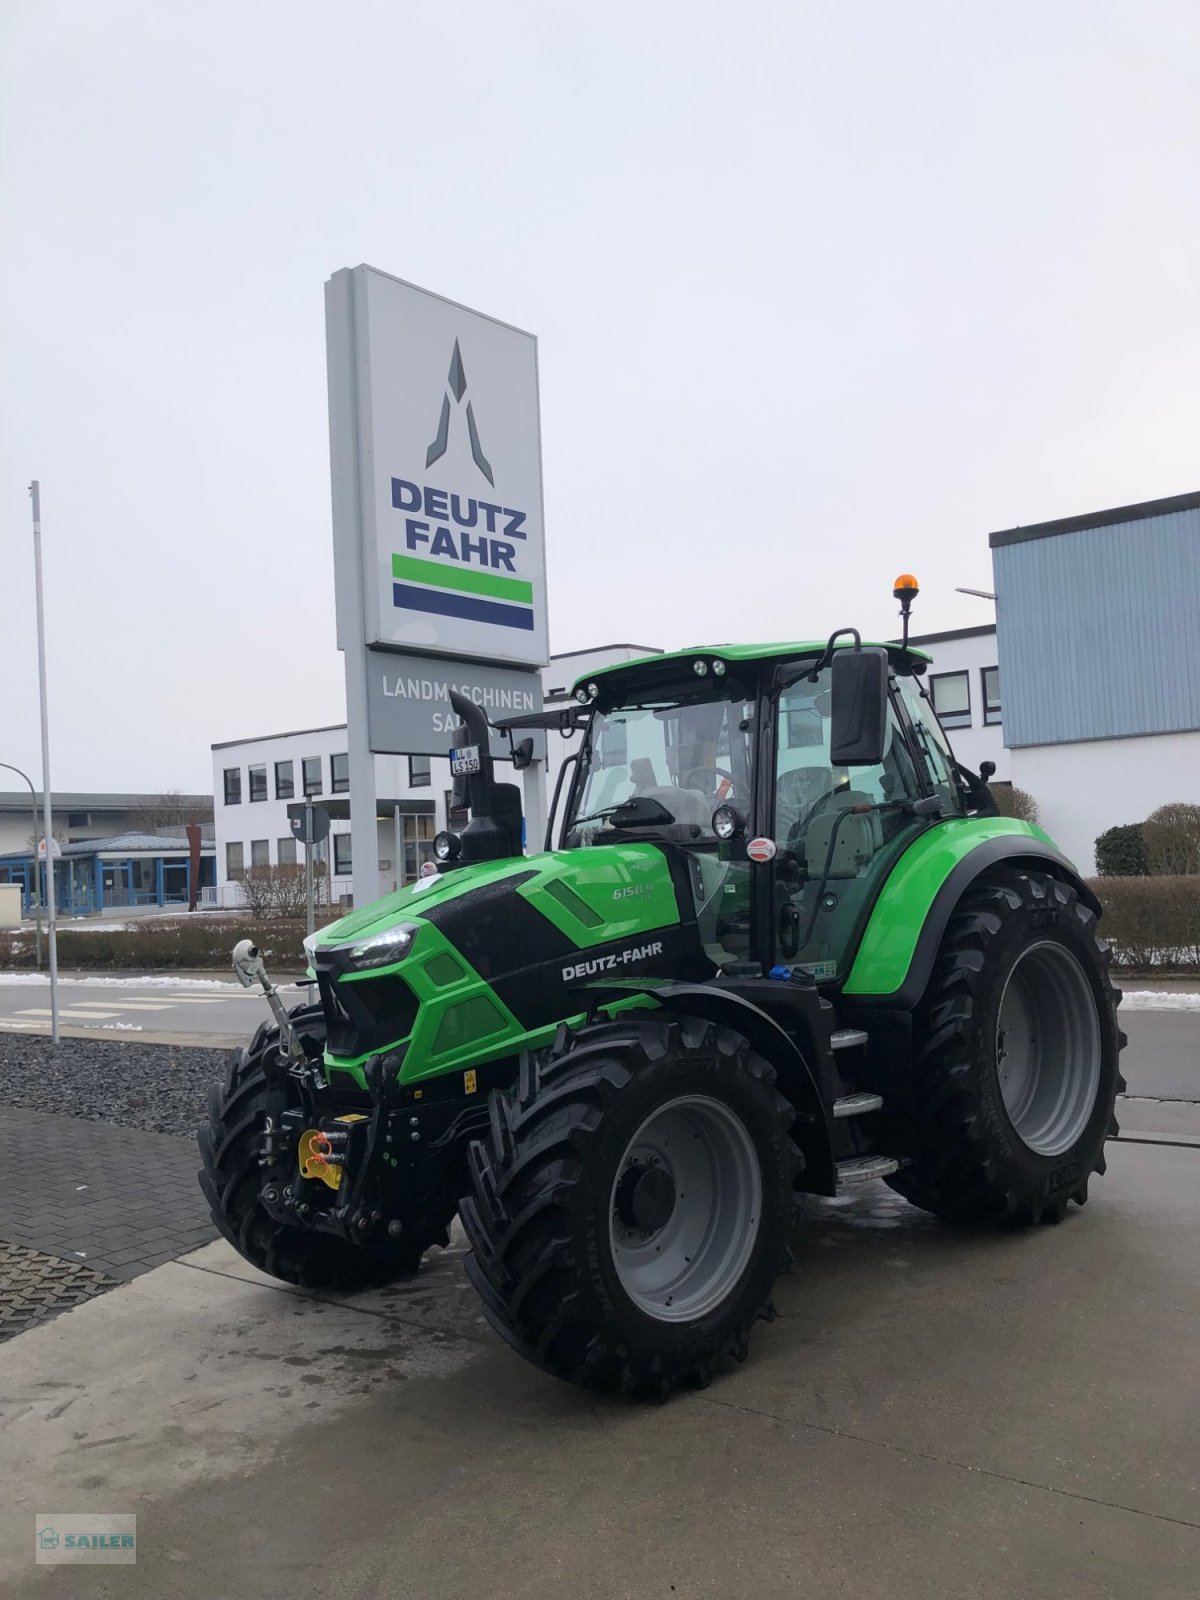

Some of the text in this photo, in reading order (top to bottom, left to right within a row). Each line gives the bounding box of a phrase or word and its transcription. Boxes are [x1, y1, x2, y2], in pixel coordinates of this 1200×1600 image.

[391, 476, 527, 540] DEUTZ
[405, 518, 517, 572] FAHR
[454, 758, 478, 773] LS 150
[455, 750, 465, 760] LL
[562, 941, 663, 981] DEUTZ-FAHR
